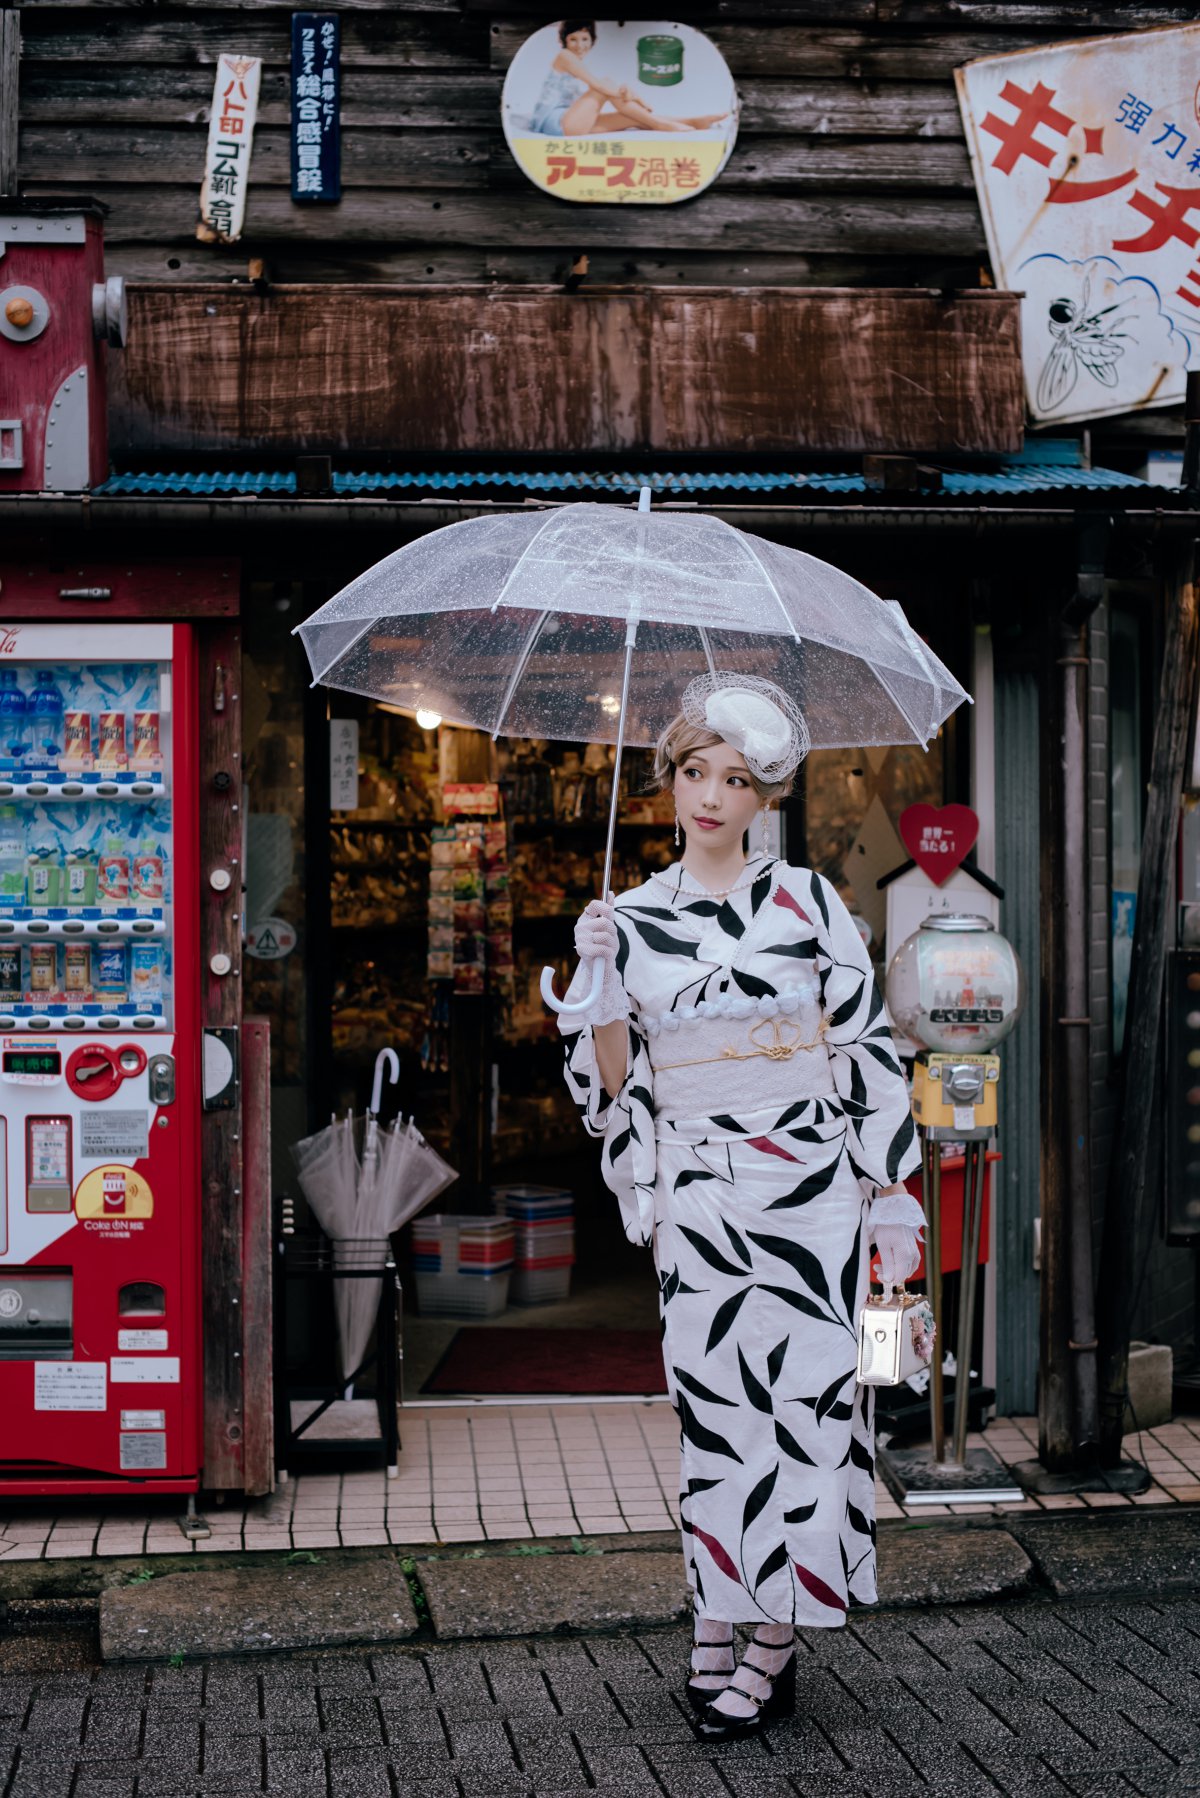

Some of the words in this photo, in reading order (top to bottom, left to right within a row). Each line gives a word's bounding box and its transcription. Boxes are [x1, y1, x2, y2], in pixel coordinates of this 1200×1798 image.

[546, 156, 701, 188] アース渦巻
[11, 1057, 54, 1071] 販売中
[84, 1220, 111, 1231] Coke
[112, 1219, 129, 1231] ON
